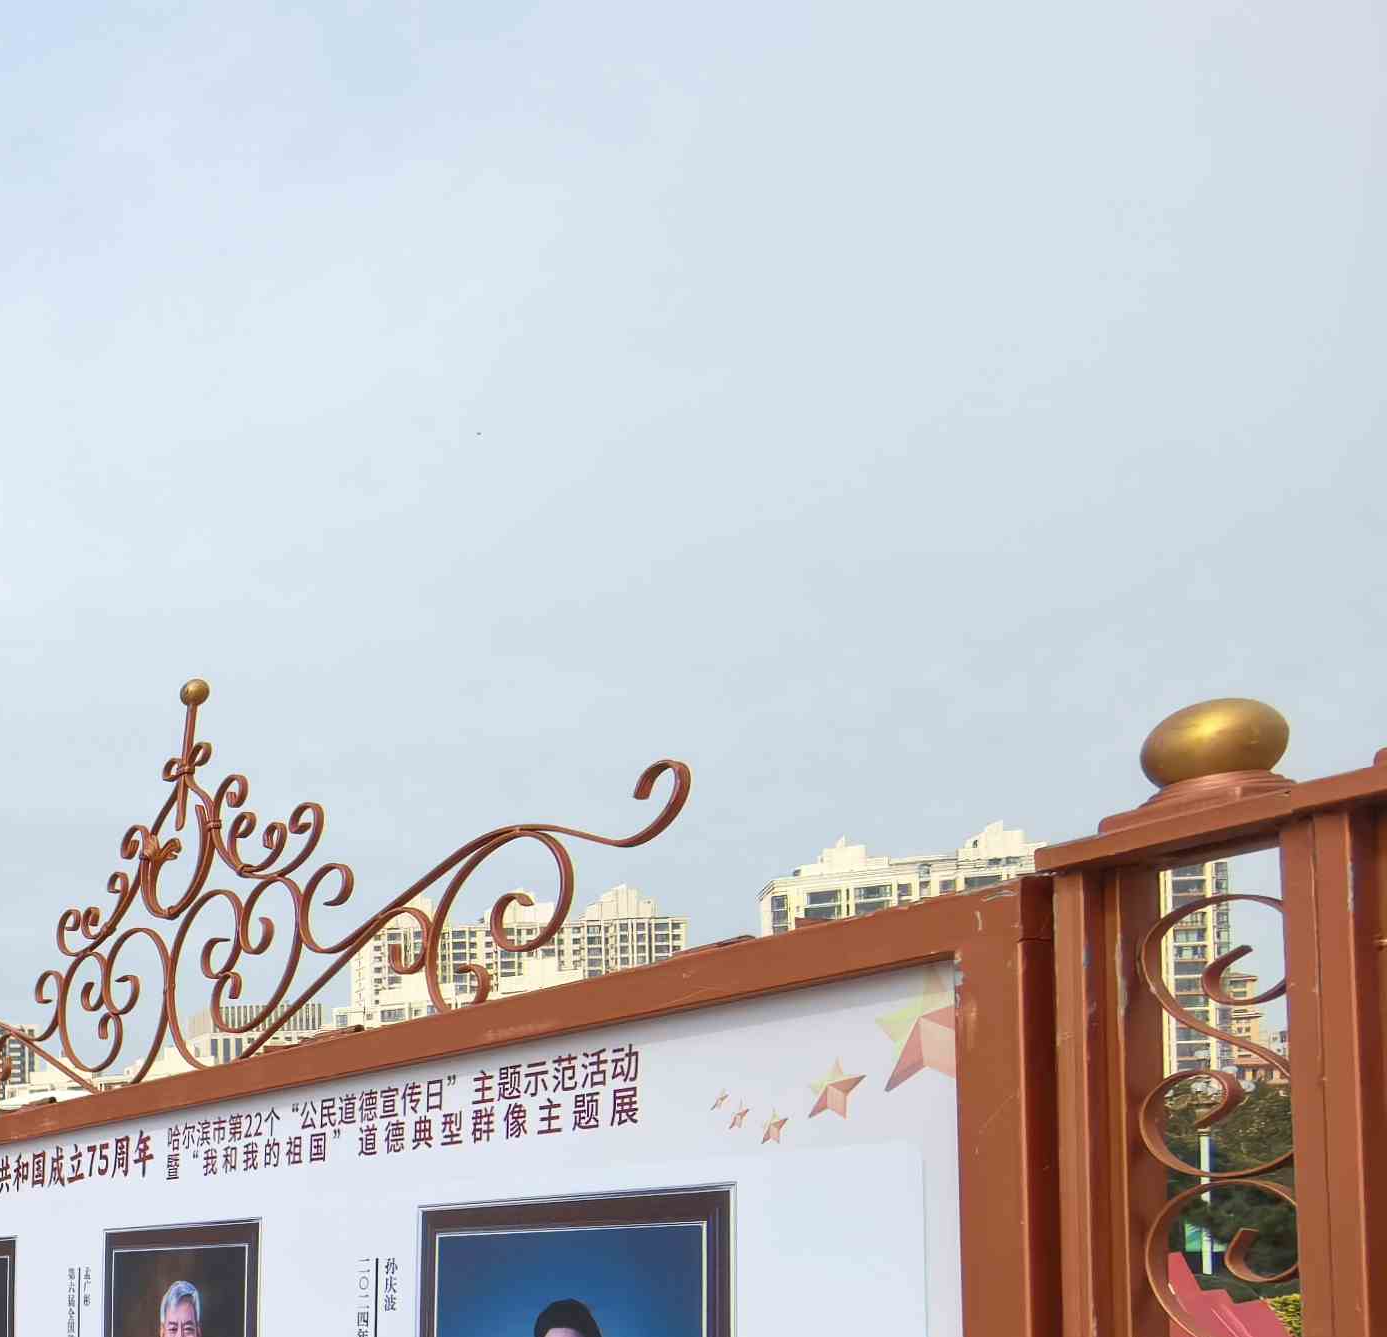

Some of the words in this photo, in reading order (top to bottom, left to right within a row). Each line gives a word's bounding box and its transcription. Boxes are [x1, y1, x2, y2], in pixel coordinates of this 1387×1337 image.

[166, 1087, 640, 1182] 暨“我和我的祖国”道德典型群像主题展
[383, 1257, 399, 1312] 孙庆波
